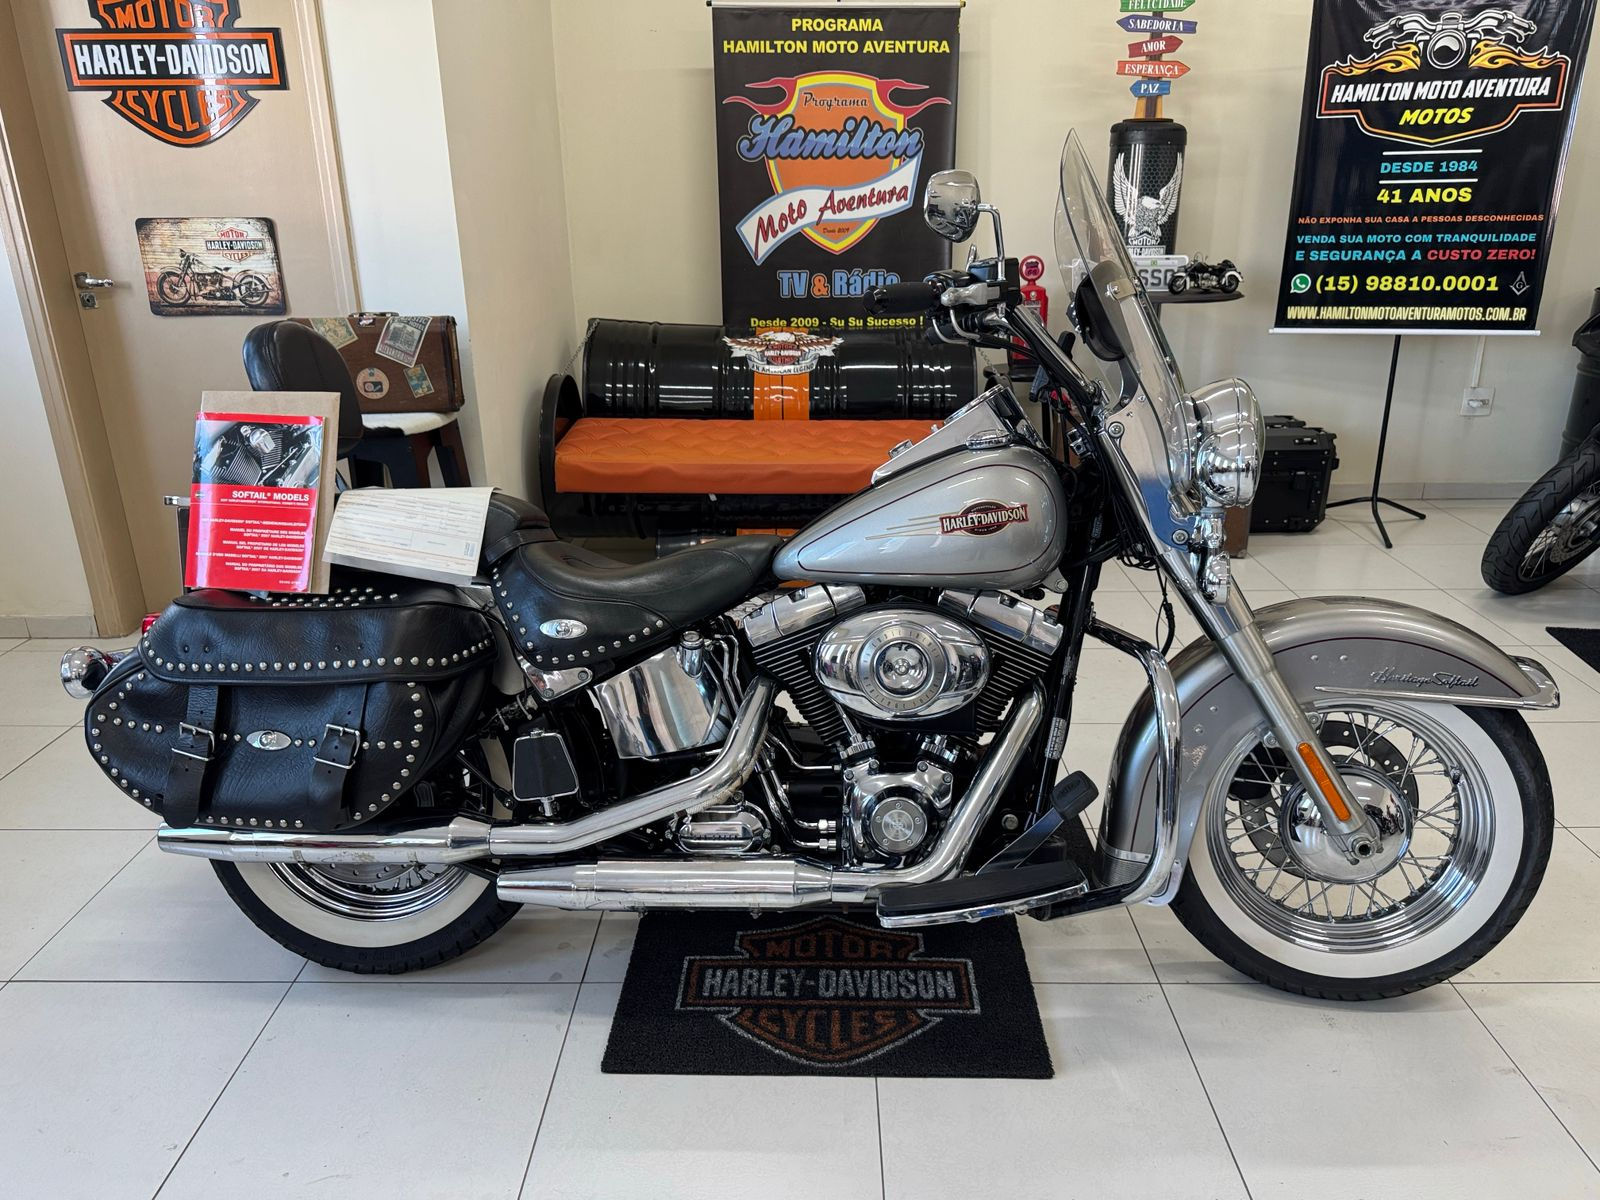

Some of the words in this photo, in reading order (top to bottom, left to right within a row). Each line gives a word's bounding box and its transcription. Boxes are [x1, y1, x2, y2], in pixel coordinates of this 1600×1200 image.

[1128, 0, 1186, 10] FELICIDADE
[115, 0, 216, 29] MOTOR
[791, 18, 884, 32] PROGRAMA
[1128, 18, 1184, 32] SABEDORIA
[723, 40, 808, 54] HAMILTON
[812, 40, 859, 54] MOTO
[862, 40, 950, 54] AVENTURA
[1140, 40, 1166, 53] AMOR
[73, 42, 271, 76] HARLEY-DAVIDSON
[1124, 63, 1178, 76] ESPERANÇA
[1140, 83, 1160, 94] PAZ
[1330, 80, 1410, 103] HAMILTON
[1414, 79, 1463, 99] MOTO
[1463, 77, 1552, 98] AVENTURA
[802, 92, 868, 110] Programa
[126, 90, 233, 133] CYCLES
[1399, 107, 1474, 126] MOTOS
[739, 116, 922, 160] Hamilton
[1380, 162, 1434, 174] DESDE
[1438, 160, 1478, 172] 1984
[1376, 189, 1402, 204] 41
[1409, 188, 1472, 204] ANOS
[754, 199, 807, 260] Moto
[816, 185, 909, 226] Aventura
[1298, 216, 1317, 224] NÃO
[1465, 214, 1544, 222] DESCONHECIDAS
[220, 229, 244, 238] MOTOR
[1297, 235, 1336, 244] VENDA
[1340, 234, 1363, 244] SUA
[1366, 234, 1402, 244] MOTO
[1404, 234, 1433, 243] COM
[1436, 232, 1537, 244] TRANQUILIDADE
[206, 240, 263, 250] HARLEY-DAVIDSON
[1132, 238, 1156, 246] MOTOR
[1296, 250, 1304, 261] E
[1310, 250, 1406, 263] SEGURANÇA
[1410, 250, 1422, 260] A
[1427, 250, 1483, 260] CUSTO
[1486, 248, 1536, 260] ZERO!
[778, 271, 808, 297] TV
[812, 275, 830, 297] &
[1316, 275, 1358, 294] (15)
[1366, 275, 1499, 292] 98810.0001
[750, 318, 787, 327] Desde
[790, 318, 819, 326] 2009
[830, 317, 844, 326] Su
[848, 317, 863, 326] Su
[866, 316, 915, 326] Sucesso
[920, 316, 924, 326] !
[1287, 306, 1526, 322] WWW.HAMILTONMOTOAVENTURAMOTOS.COM.BR
[273, 492, 310, 502] MODELS
[942, 507, 1026, 532] HARLEY-DAVIDSON
[1370, 667, 1432, 686] Heritage
[1432, 672, 1479, 689] Softail
[767, 928, 892, 959] MOTOR
[702, 968, 957, 999] HARLEY-DAVIDSON
[758, 1007, 897, 1050] CYCLES
